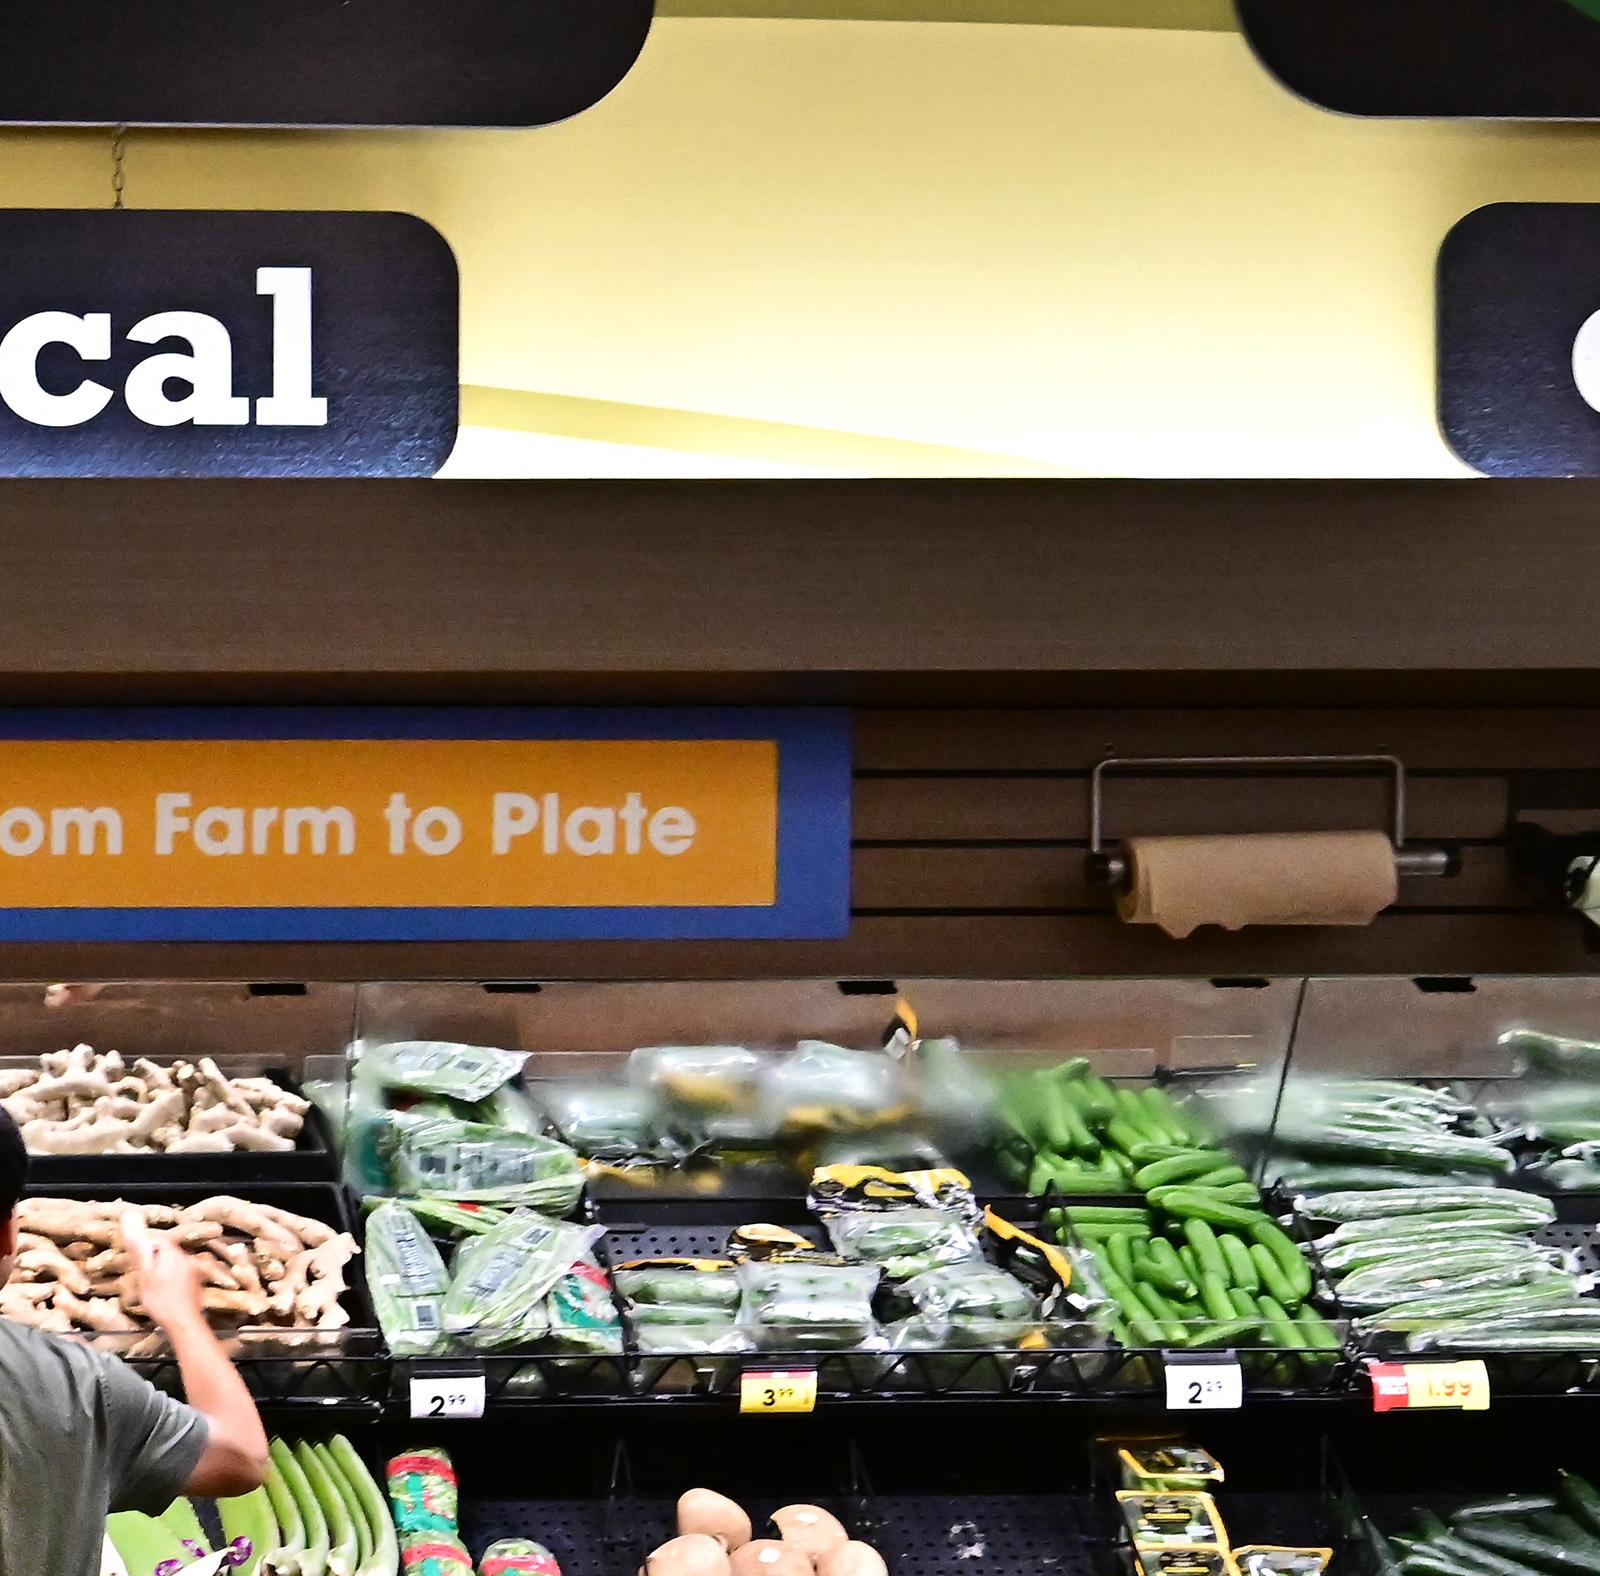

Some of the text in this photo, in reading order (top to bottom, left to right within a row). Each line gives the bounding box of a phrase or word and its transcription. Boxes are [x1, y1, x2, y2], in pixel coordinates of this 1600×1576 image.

[154, 792, 356, 856] Farm
[385, 793, 462, 856] to
[491, 792, 697, 856] Plate
[1426, 1378, 1472, 1398] 1.99
